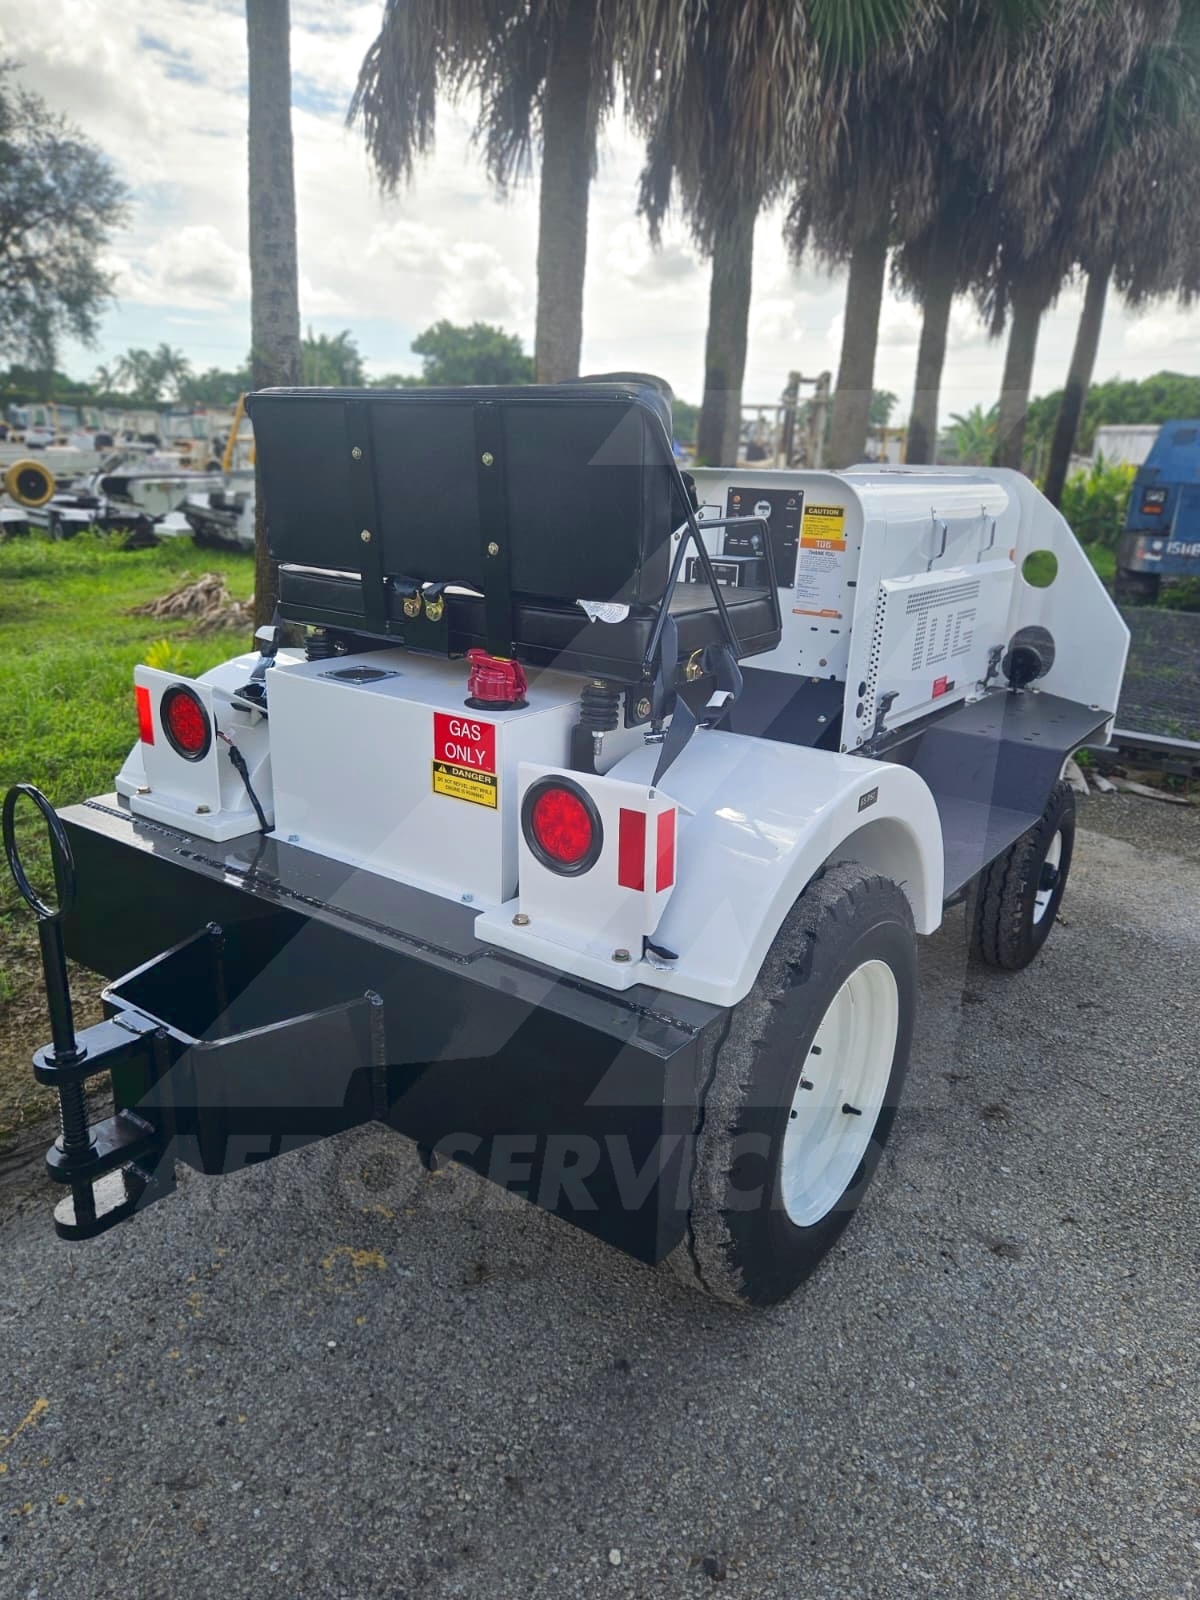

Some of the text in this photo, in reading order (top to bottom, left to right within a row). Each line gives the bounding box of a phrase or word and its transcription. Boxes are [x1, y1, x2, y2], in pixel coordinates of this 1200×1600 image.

[808, 507, 840, 516] CAUTION
[815, 539, 832, 549] TUG
[905, 580, 980, 671] TUG
[449, 720, 481, 741] GAS
[445, 742, 486, 765] ONLY
[452, 767, 492, 784] DANGER
